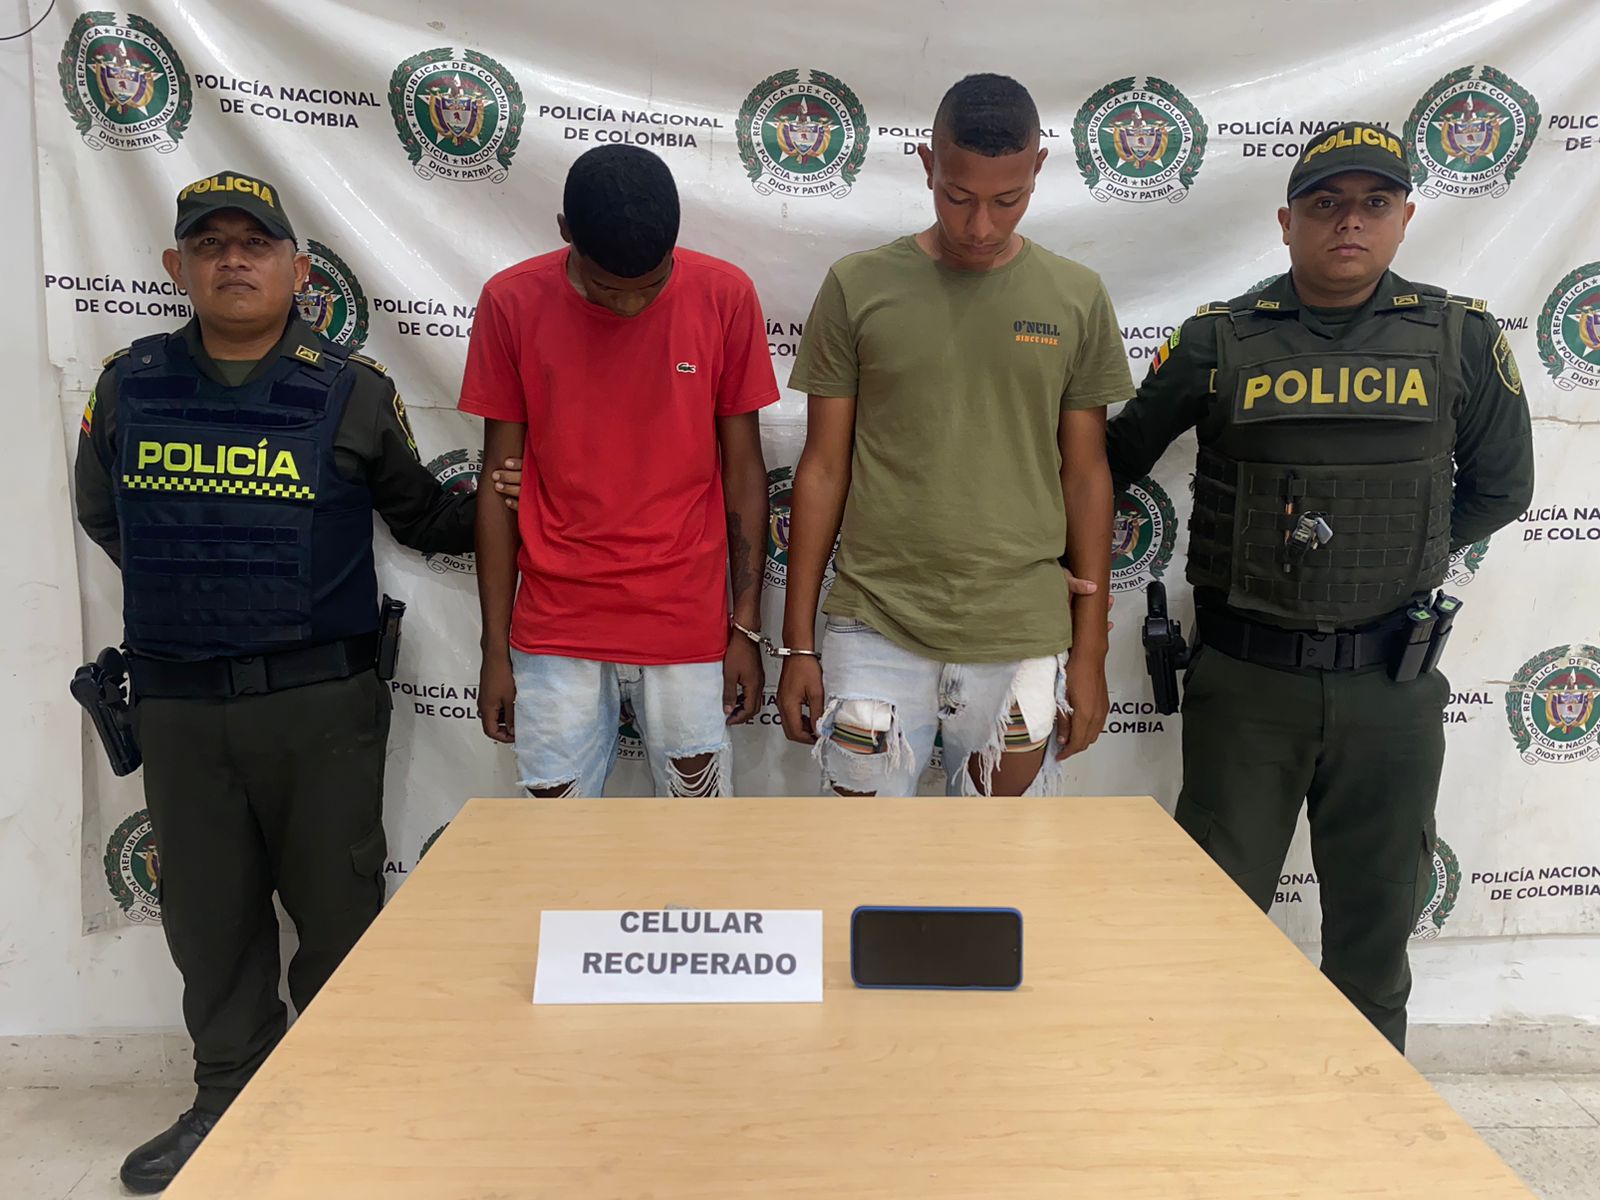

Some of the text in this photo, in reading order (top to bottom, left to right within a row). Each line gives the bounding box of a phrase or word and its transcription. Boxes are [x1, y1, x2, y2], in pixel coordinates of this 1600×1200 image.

[115, 28, 132, 38] DE
[143, 38, 178, 96] COLOMBIA
[195, 74, 381, 107] POLICÍA NACIONAL
[452, 62, 467, 71] DE
[477, 70, 507, 121] COLOMBIA
[219, 98, 359, 128] DE COLOMBIA
[539, 105, 724, 128] POLICÍA NACIONAL
[798, 85, 813, 93] DE
[823, 92, 853, 140] COLOMBIA
[1132, 92, 1147, 100] DE
[1156, 99, 1191, 143] COLOMBIA
[1467, 82, 1480, 90] DE
[1489, 88, 1524, 136] COLOMBIA
[125, 107, 174, 133] NACIONAL
[1217, 118, 1294, 135] POLICÍA
[1548, 115, 1599, 129] POLIC
[127, 134, 161, 147] PATRIA
[564, 127, 698, 148] DE COLOMBIA
[878, 127, 933, 137] POLIC
[461, 134, 503, 165] NACIONAL
[1243, 143, 1267, 157] DE
[1303, 127, 1402, 163] POLICIA
[1566, 136, 1592, 151] DE
[462, 164, 493, 178] PATRIA
[802, 151, 849, 182] NACIONAL
[1140, 155, 1186, 186] NACIONAL
[1471, 149, 1516, 181] NACIONAL
[180, 176, 275, 208] POLICIA
[802, 181, 837, 194] PATRIA
[1140, 184, 1174, 199] PATRIA
[1468, 180, 1498, 195] PATRIA
[45, 274, 188, 296] POLICÍA NACI
[322, 261, 355, 315] COLOMBIA
[75, 298, 192, 318] DE COLOMBI
[373, 298, 447, 316] POLICÍA
[398, 321, 421, 336] DE
[1013, 320, 1060, 336] O'NEILL
[1120, 326, 1175, 339] NACIO
[1496, 317, 1528, 330] ONAL
[1243, 367, 1428, 410] POLICIA
[137, 437, 300, 480] POLICÍA
[1133, 488, 1161, 538] COLOMBIA
[1517, 504, 1568, 522] OLICÍA
[1523, 528, 1600, 541] DE COLO
[1112, 549, 1157, 578] NACIONAL
[1111, 576, 1145, 590] PATRIA
[391, 681, 458, 699] POLICÍA
[1448, 693, 1494, 704] ONAL
[414, 702, 435, 716] DE
[1109, 702, 1155, 714] ACIO
[1101, 721, 1164, 733] OMBIA
[1566, 722, 1600, 749] NACIONA
[1564, 745, 1592, 760] PATRIA
[1433, 856, 1445, 890] OMBIA
[1471, 866, 1600, 884] POLICÍA NACION
[1490, 884, 1600, 900] DE COLOMBIA
[1419, 900, 1439, 920] ONAL
[620, 911, 763, 933] CELULAR
[582, 952, 797, 975] RECUPERADO
